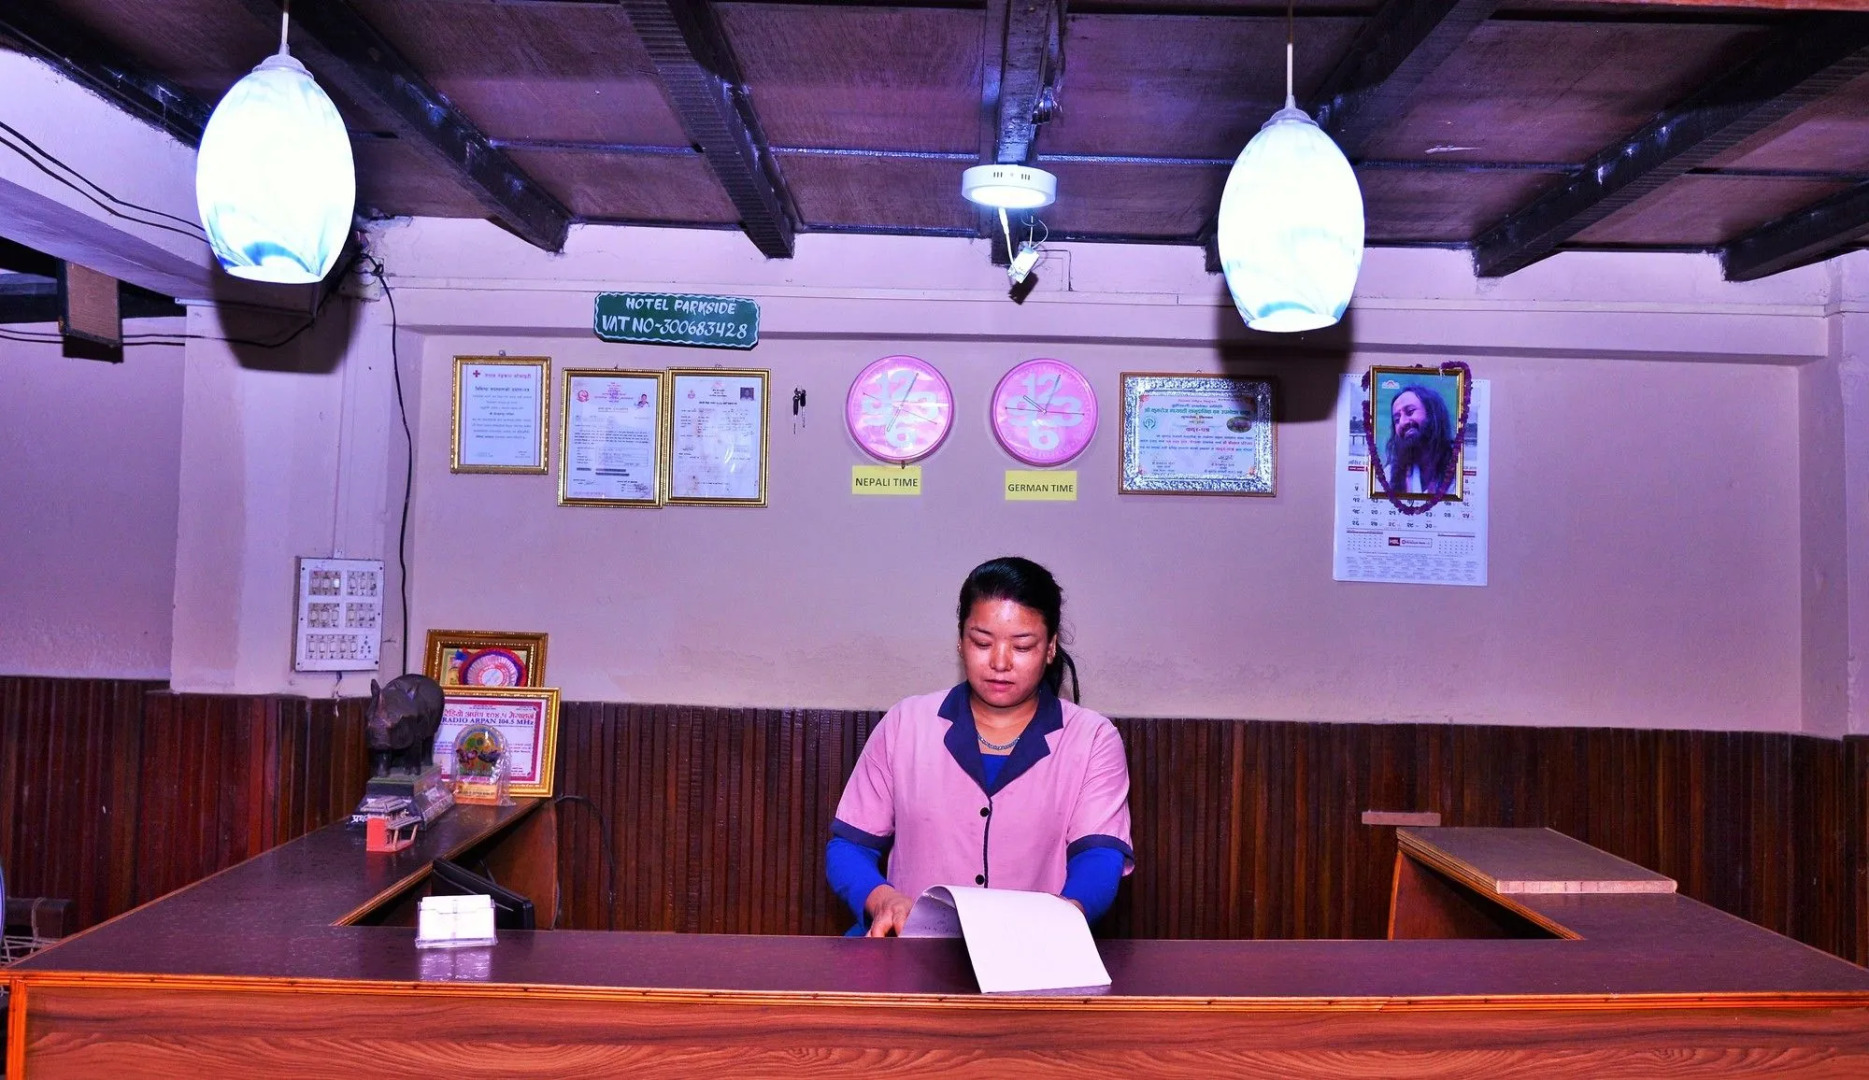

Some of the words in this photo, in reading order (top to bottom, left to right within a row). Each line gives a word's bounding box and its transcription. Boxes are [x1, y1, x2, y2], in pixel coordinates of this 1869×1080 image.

[625, 297, 669, 311] HOTEL
[674, 299, 737, 316] PARKSIDE
[602, 315, 631, 332] VAT
[855, 477, 891, 487] NEPALI
[892, 477, 919, 487] TIME
[1007, 483, 1049, 493] GERMAN
[1050, 484, 1074, 493] TIME
